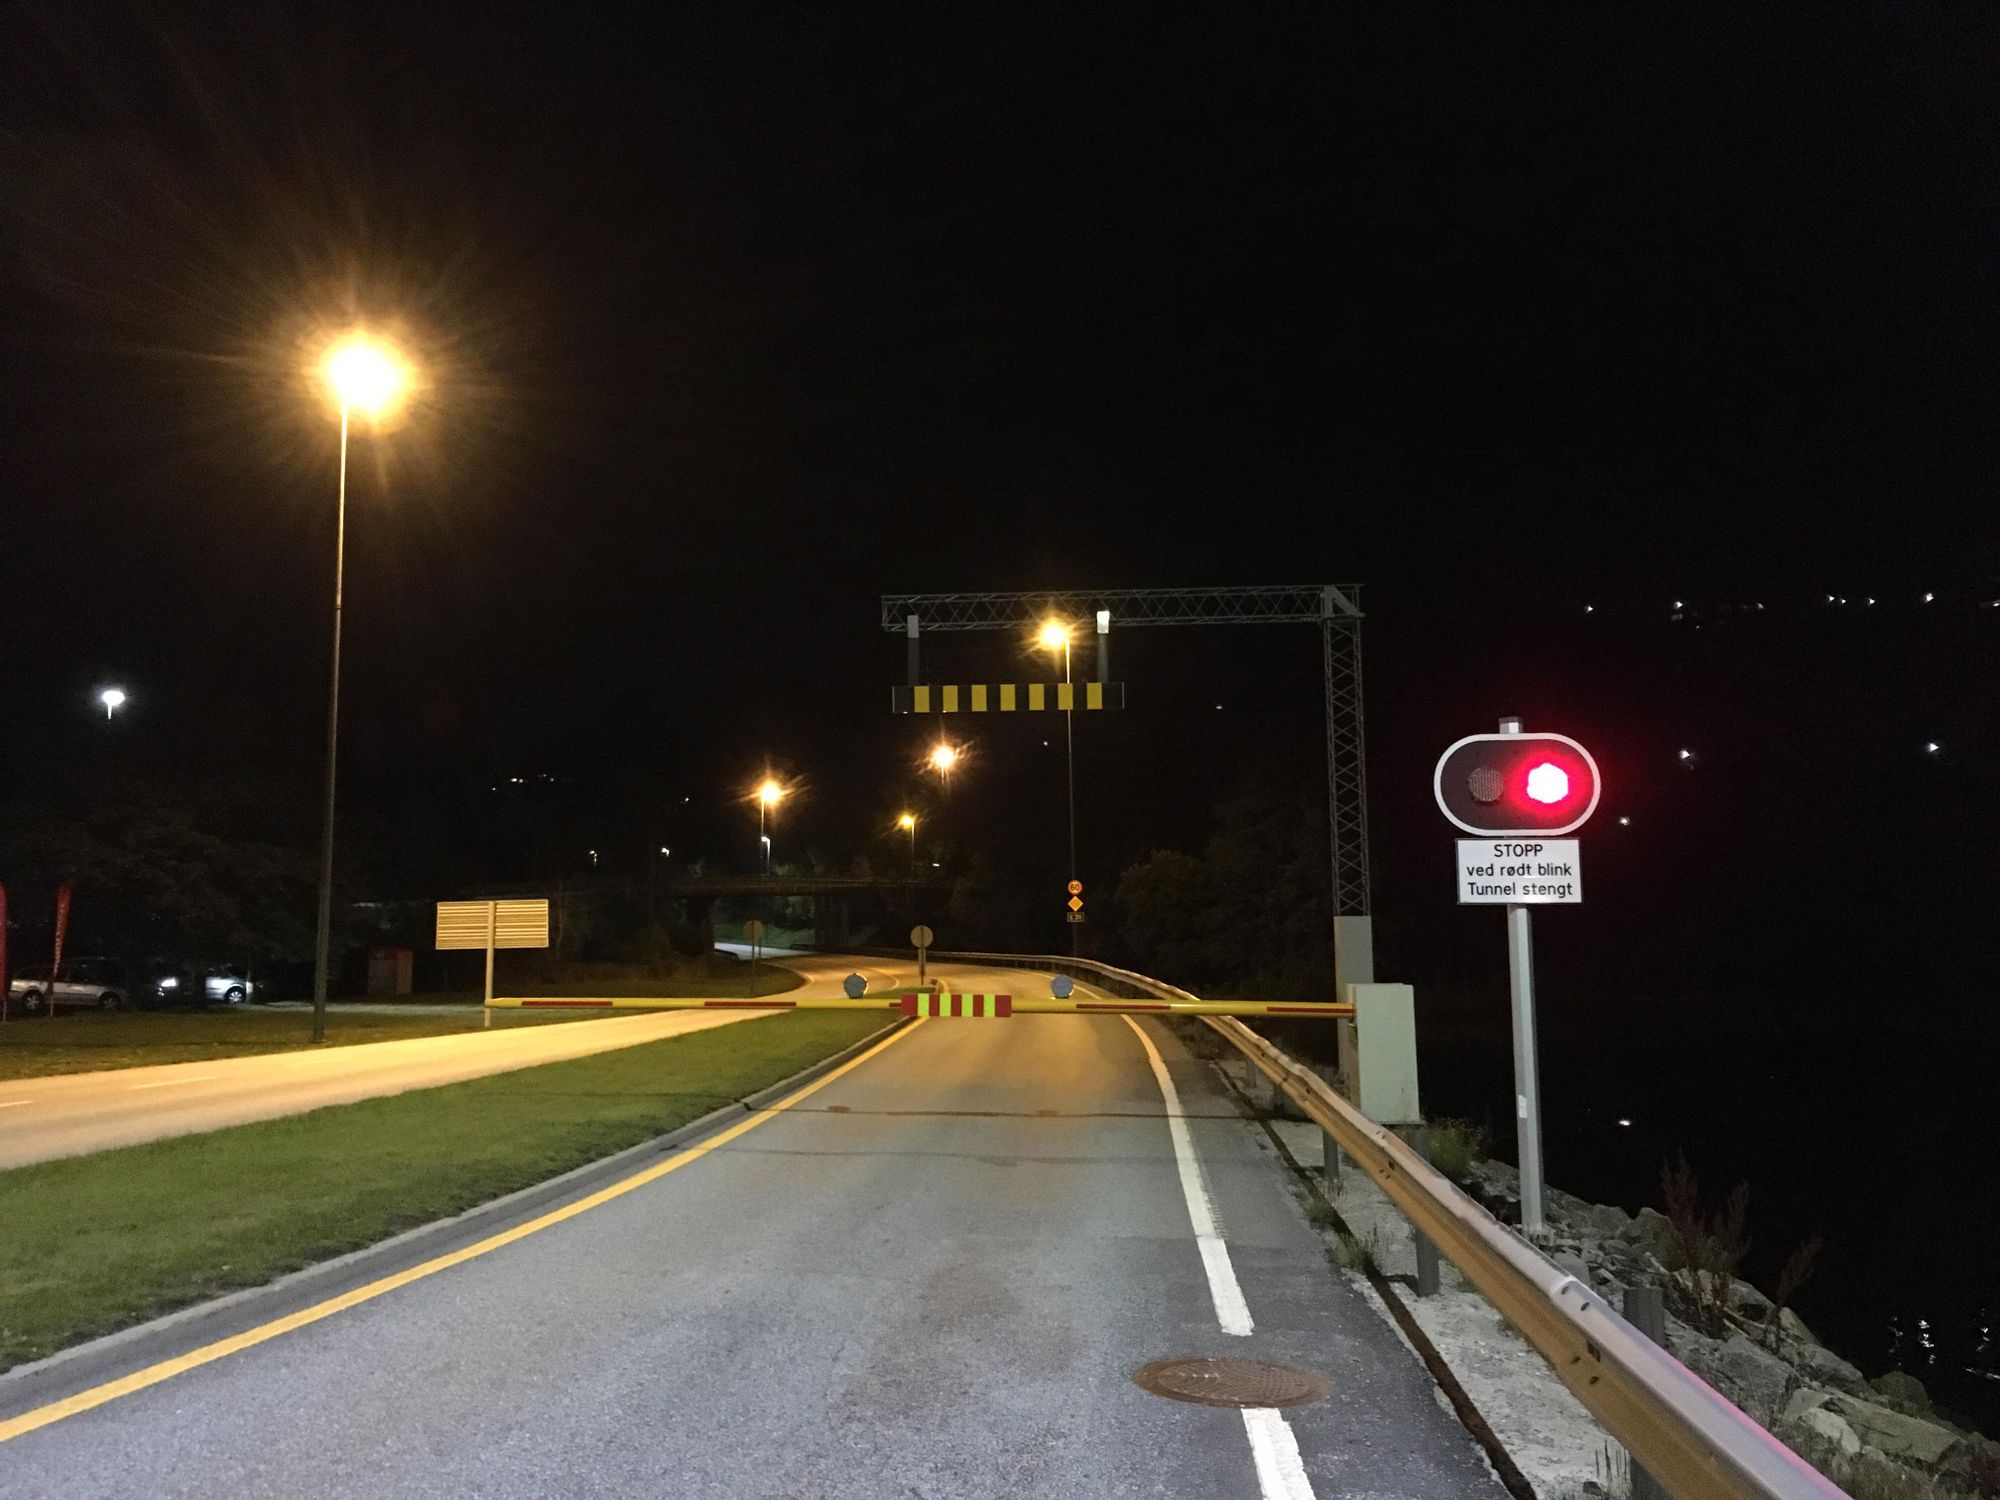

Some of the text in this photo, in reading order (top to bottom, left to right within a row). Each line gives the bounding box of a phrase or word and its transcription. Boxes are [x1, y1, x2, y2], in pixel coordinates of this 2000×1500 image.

[1493, 843, 1543, 858] STOPP
[1466, 863, 1572, 876] ved rødt blink
[1468, 882, 1573, 899] Tunnel stengt
